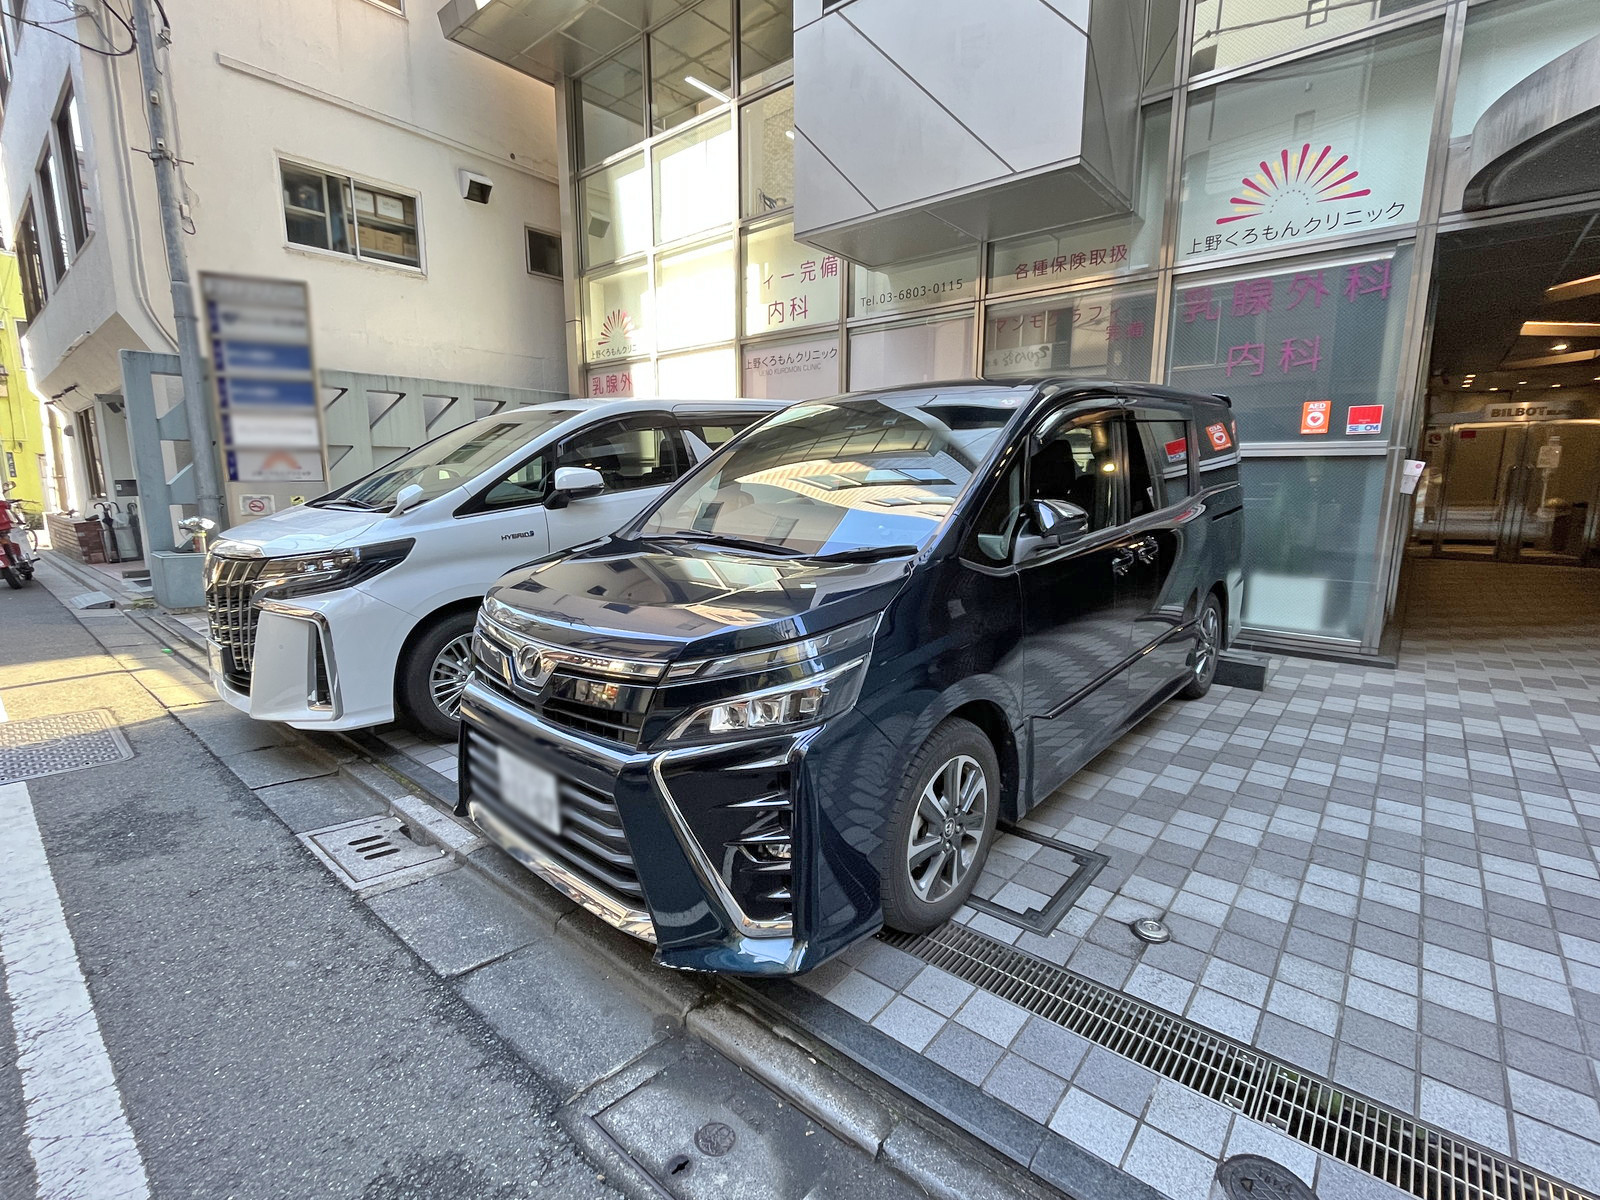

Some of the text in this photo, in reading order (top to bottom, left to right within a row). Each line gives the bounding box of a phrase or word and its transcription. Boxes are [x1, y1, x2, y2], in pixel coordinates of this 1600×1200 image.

[1186, 201, 1405, 256] 上野くろもんクリニック
[1015, 244, 1128, 280] 各種保険取扱
[1185, 260, 1392, 323] 乳腺外科
[768, 294, 808, 325] 内科
[745, 347, 838, 370] 上野くろもんクリニック
[1226, 336, 1321, 377] 内科
[592, 372, 632, 396] 乳腺外
[1307, 402, 1327, 410] AED
[1490, 406, 1548, 417] BILBOT
[1348, 424, 1380, 432] SEOM
[501, 531, 530, 540] HYBRID
